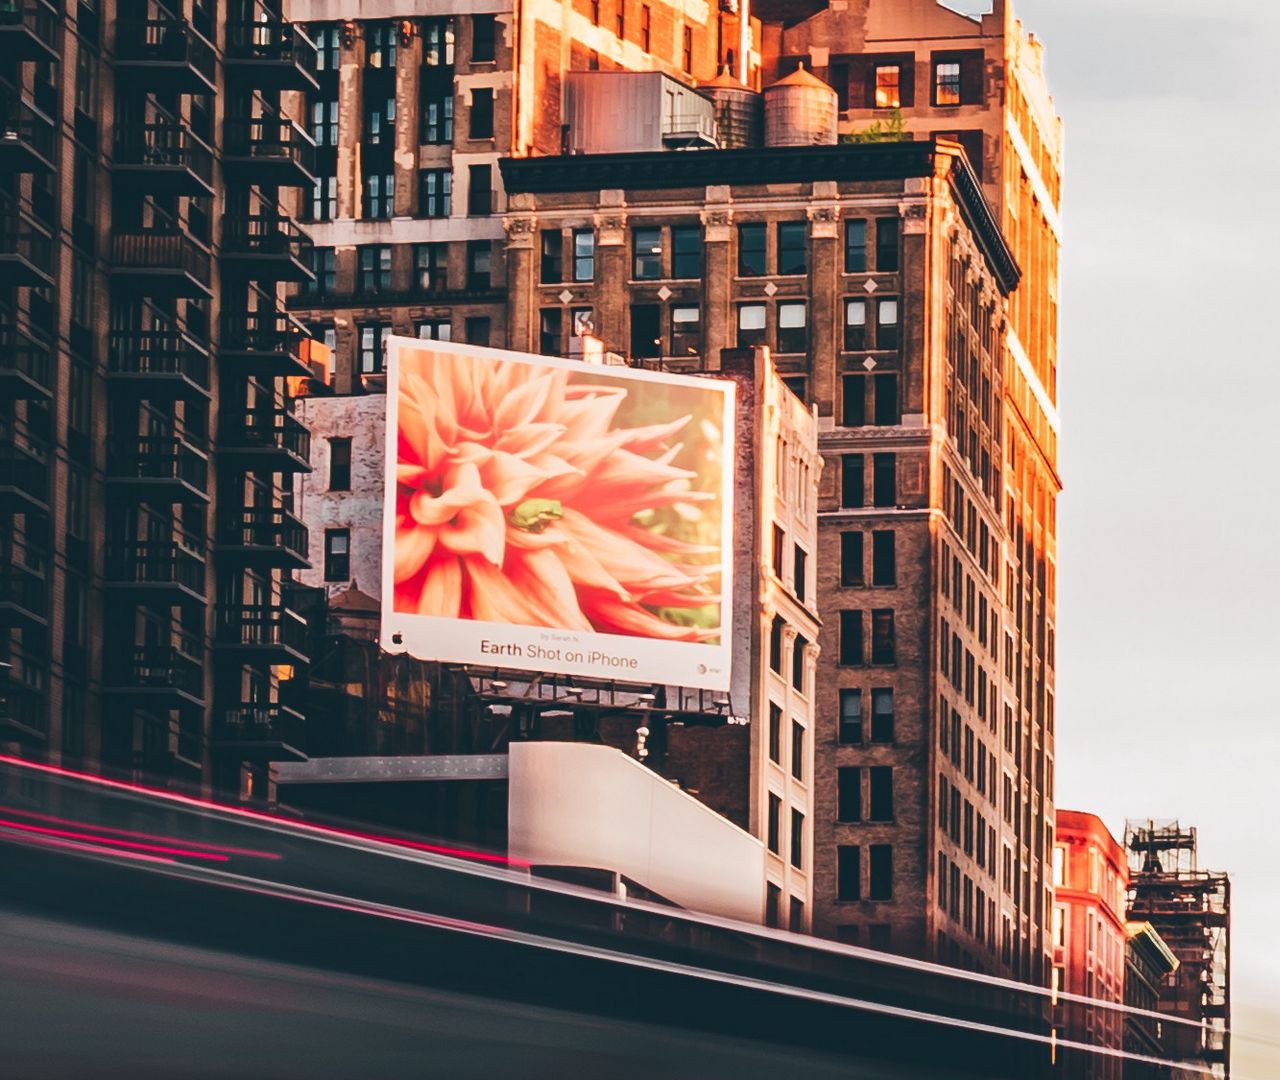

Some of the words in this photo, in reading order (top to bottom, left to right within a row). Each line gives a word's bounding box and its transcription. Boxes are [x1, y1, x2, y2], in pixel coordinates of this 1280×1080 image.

[480, 639, 522, 657] Earth
[527, 644, 561, 661] Shot
[565, 651, 584, 664] on
[587, 651, 638, 669] iPhone
